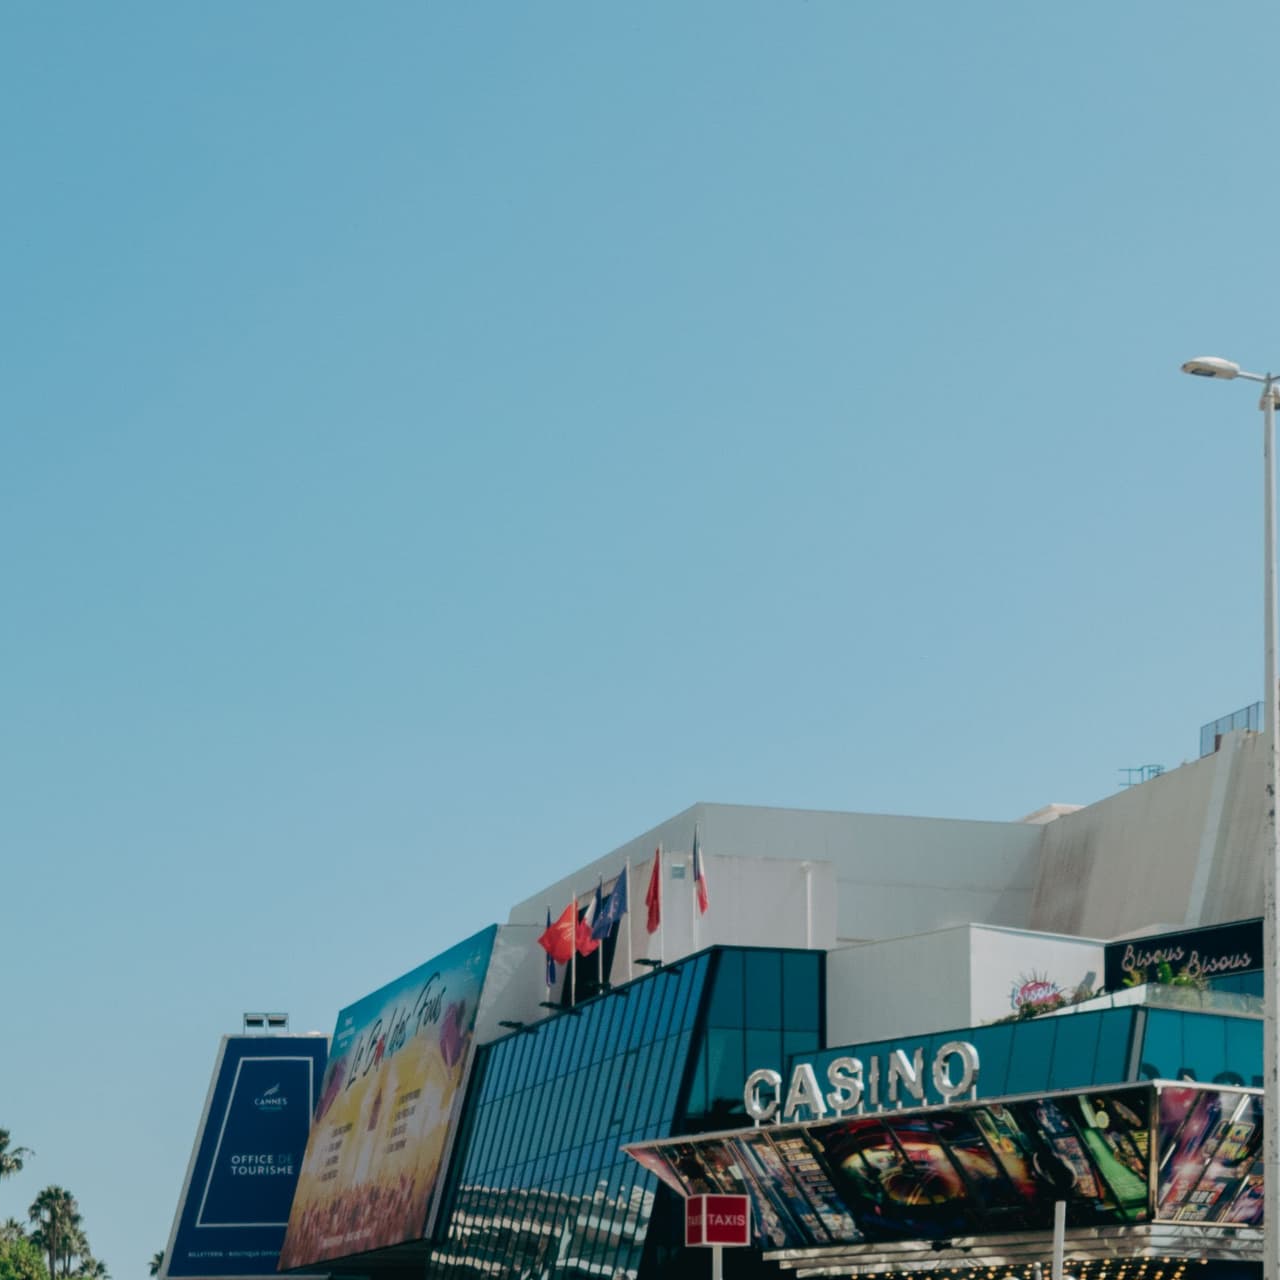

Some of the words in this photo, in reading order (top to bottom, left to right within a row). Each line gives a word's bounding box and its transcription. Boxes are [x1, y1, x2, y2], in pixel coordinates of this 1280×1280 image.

[1121, 944, 1184, 972] Bisous
[1186, 950, 1252, 978] Bisous
[743, 1041, 980, 1122] CASINO
[254, 1097, 288, 1106] CANNES
[231, 1154, 273, 1164] OFFICE
[277, 1154, 294, 1164] DE
[231, 1165, 294, 1175] TOURISME
[707, 1213, 746, 1227] TAXIS
